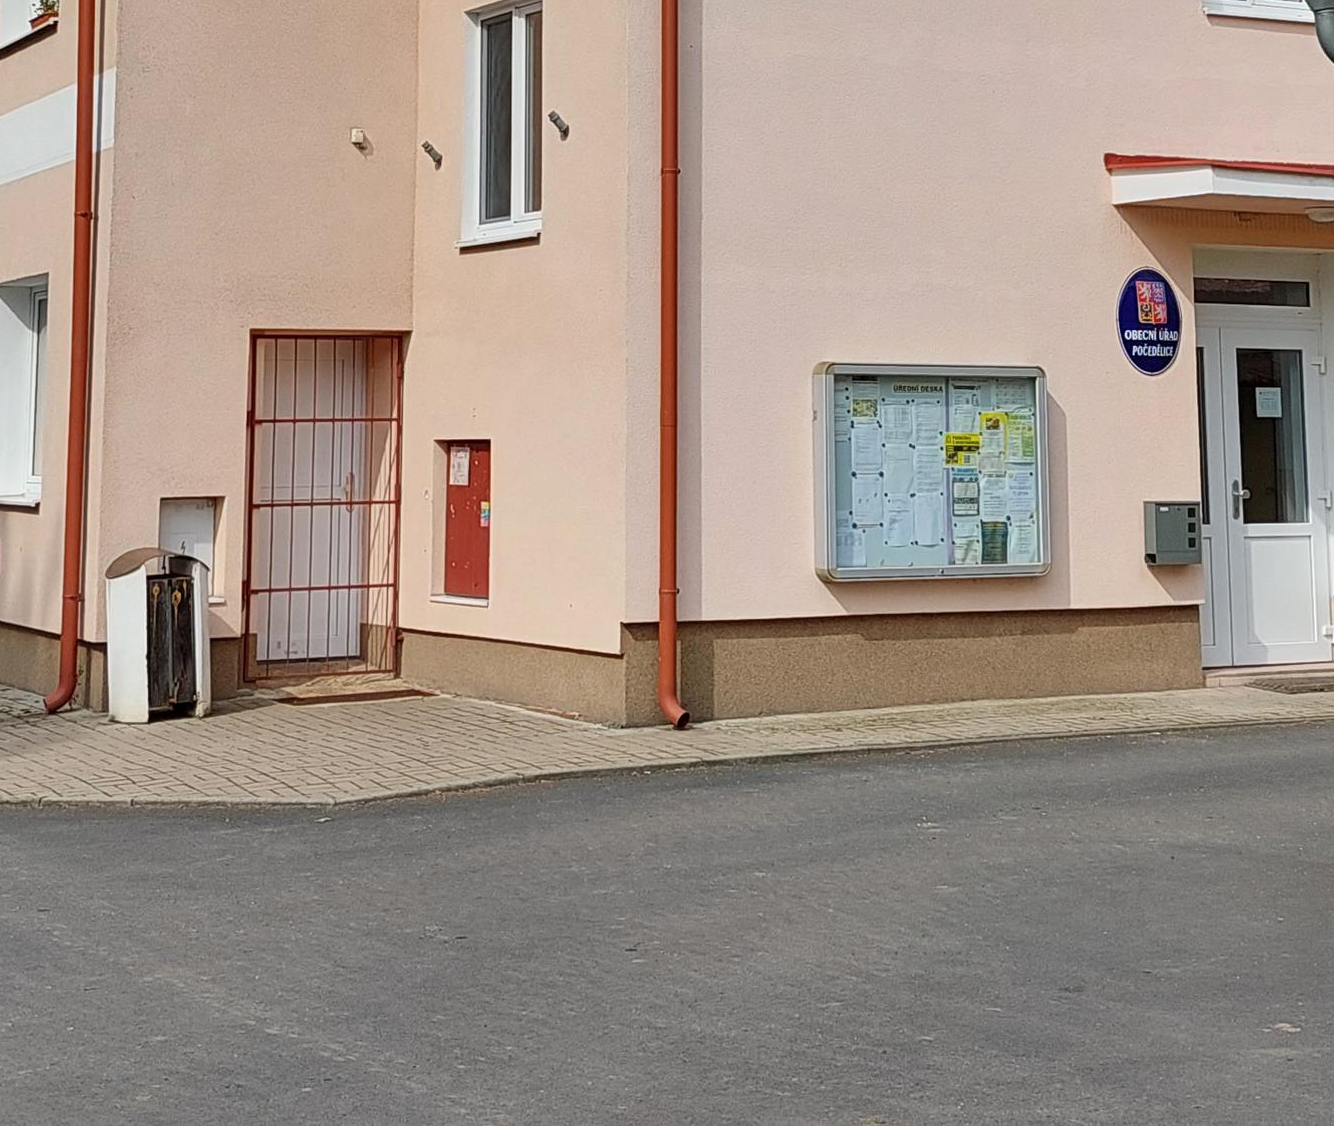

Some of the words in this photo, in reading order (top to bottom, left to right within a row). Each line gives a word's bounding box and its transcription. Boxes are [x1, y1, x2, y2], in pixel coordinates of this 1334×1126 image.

[1124, 328, 1157, 341] OBECNÍ
[1158, 328, 1178, 341] ÚŘAD
[1132, 343, 1174, 356] POČEDĚLICE
